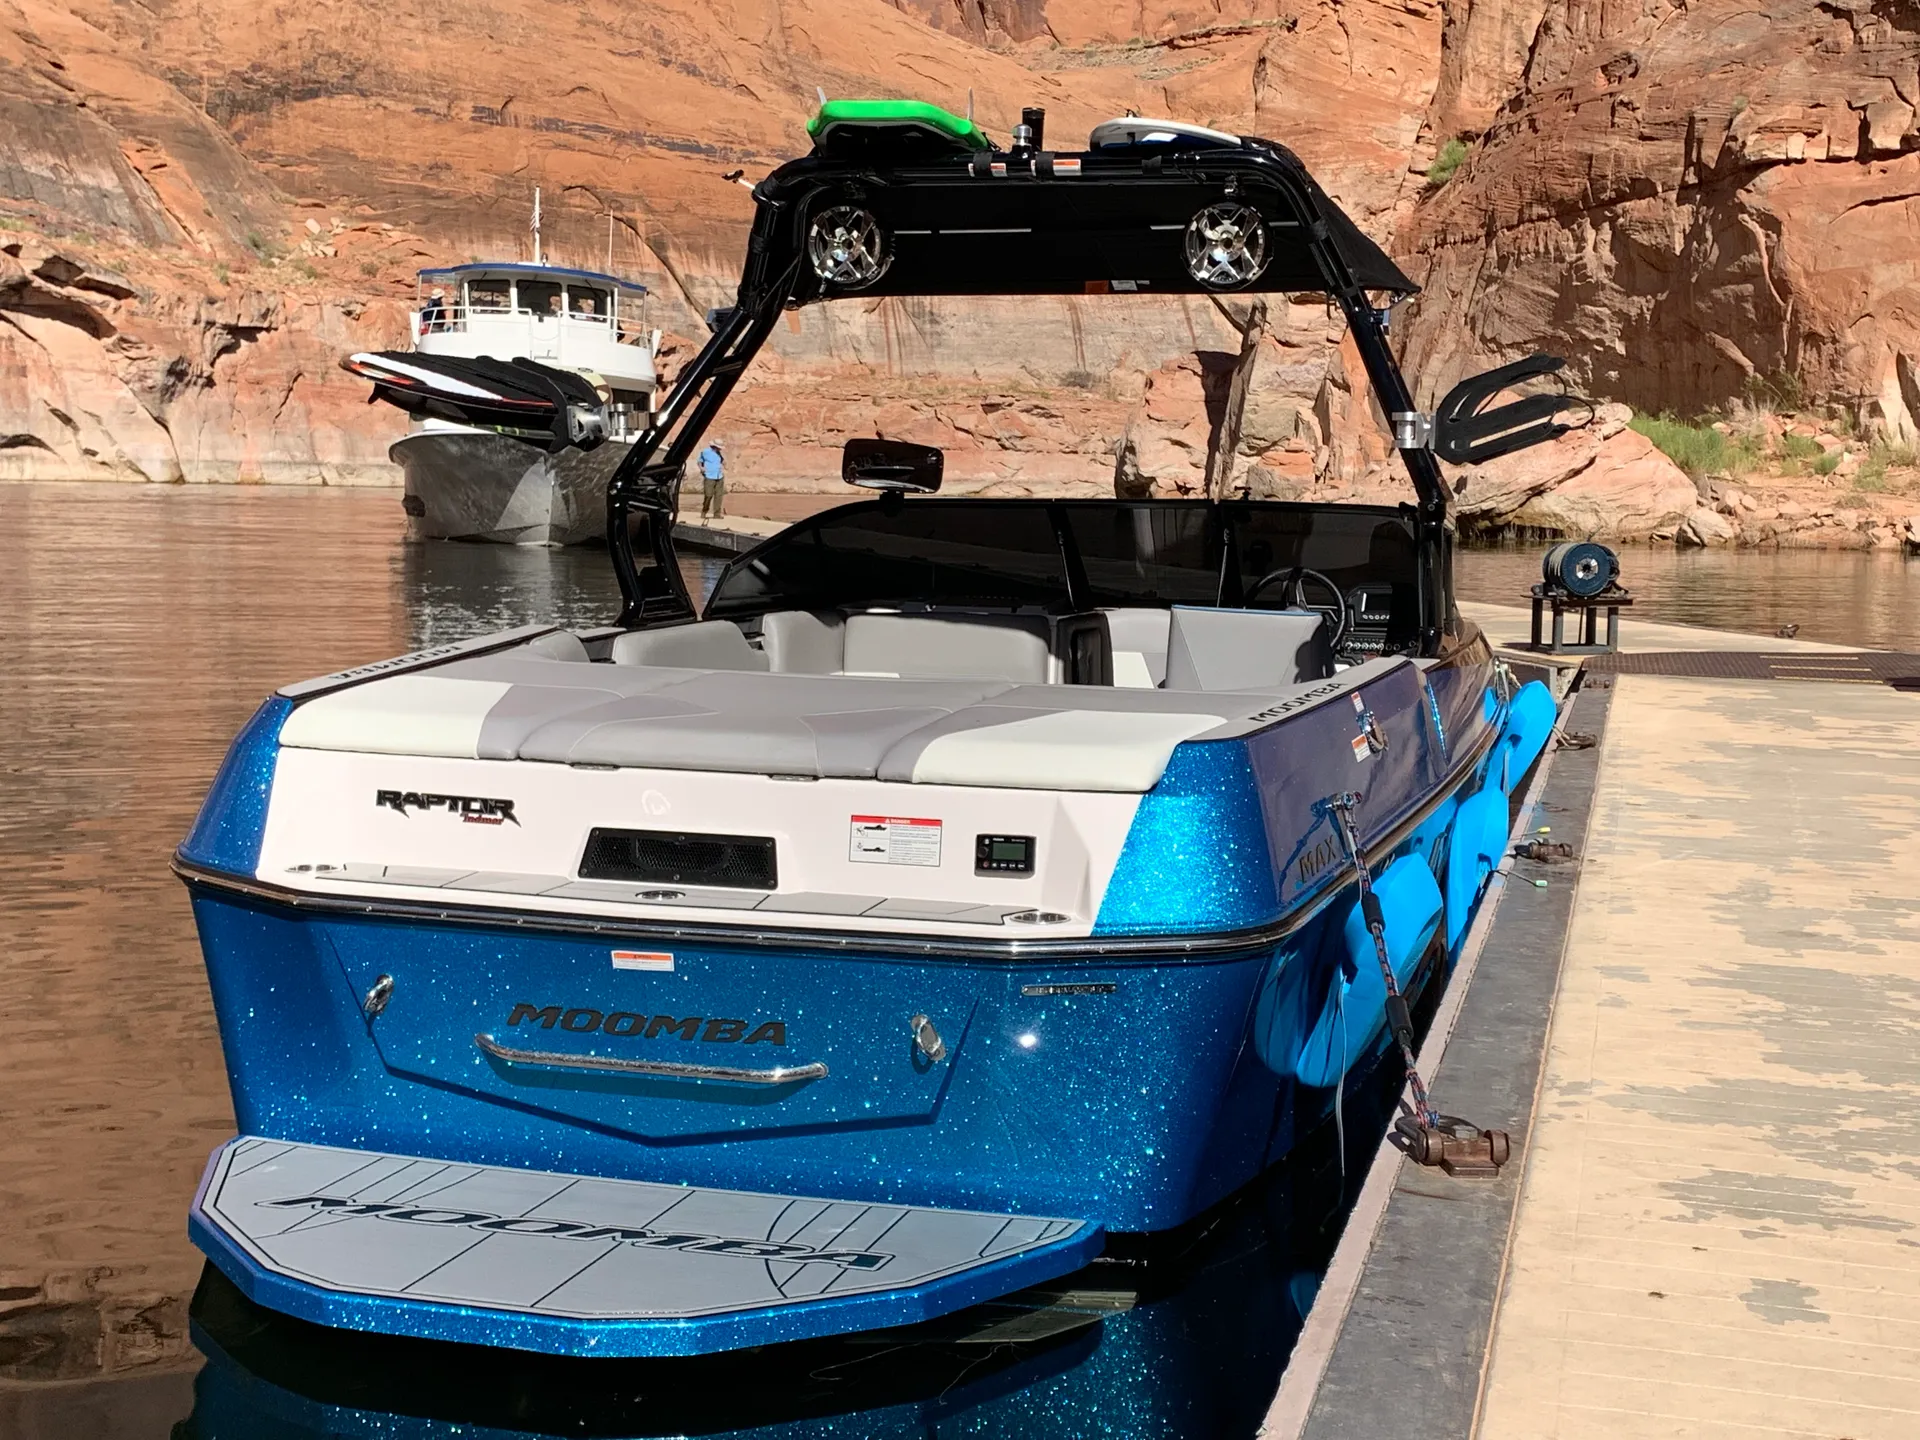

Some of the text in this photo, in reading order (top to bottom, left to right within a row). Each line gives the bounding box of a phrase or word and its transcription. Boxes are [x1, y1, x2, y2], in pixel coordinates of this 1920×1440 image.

[1248, 682, 1348, 722] MOOMBA
[376, 789, 522, 828] RAPTOR
[1299, 834, 1336, 884] MAX
[507, 1003, 786, 1046] MOOMBA
[256, 1196, 893, 1270] MOOMBA
